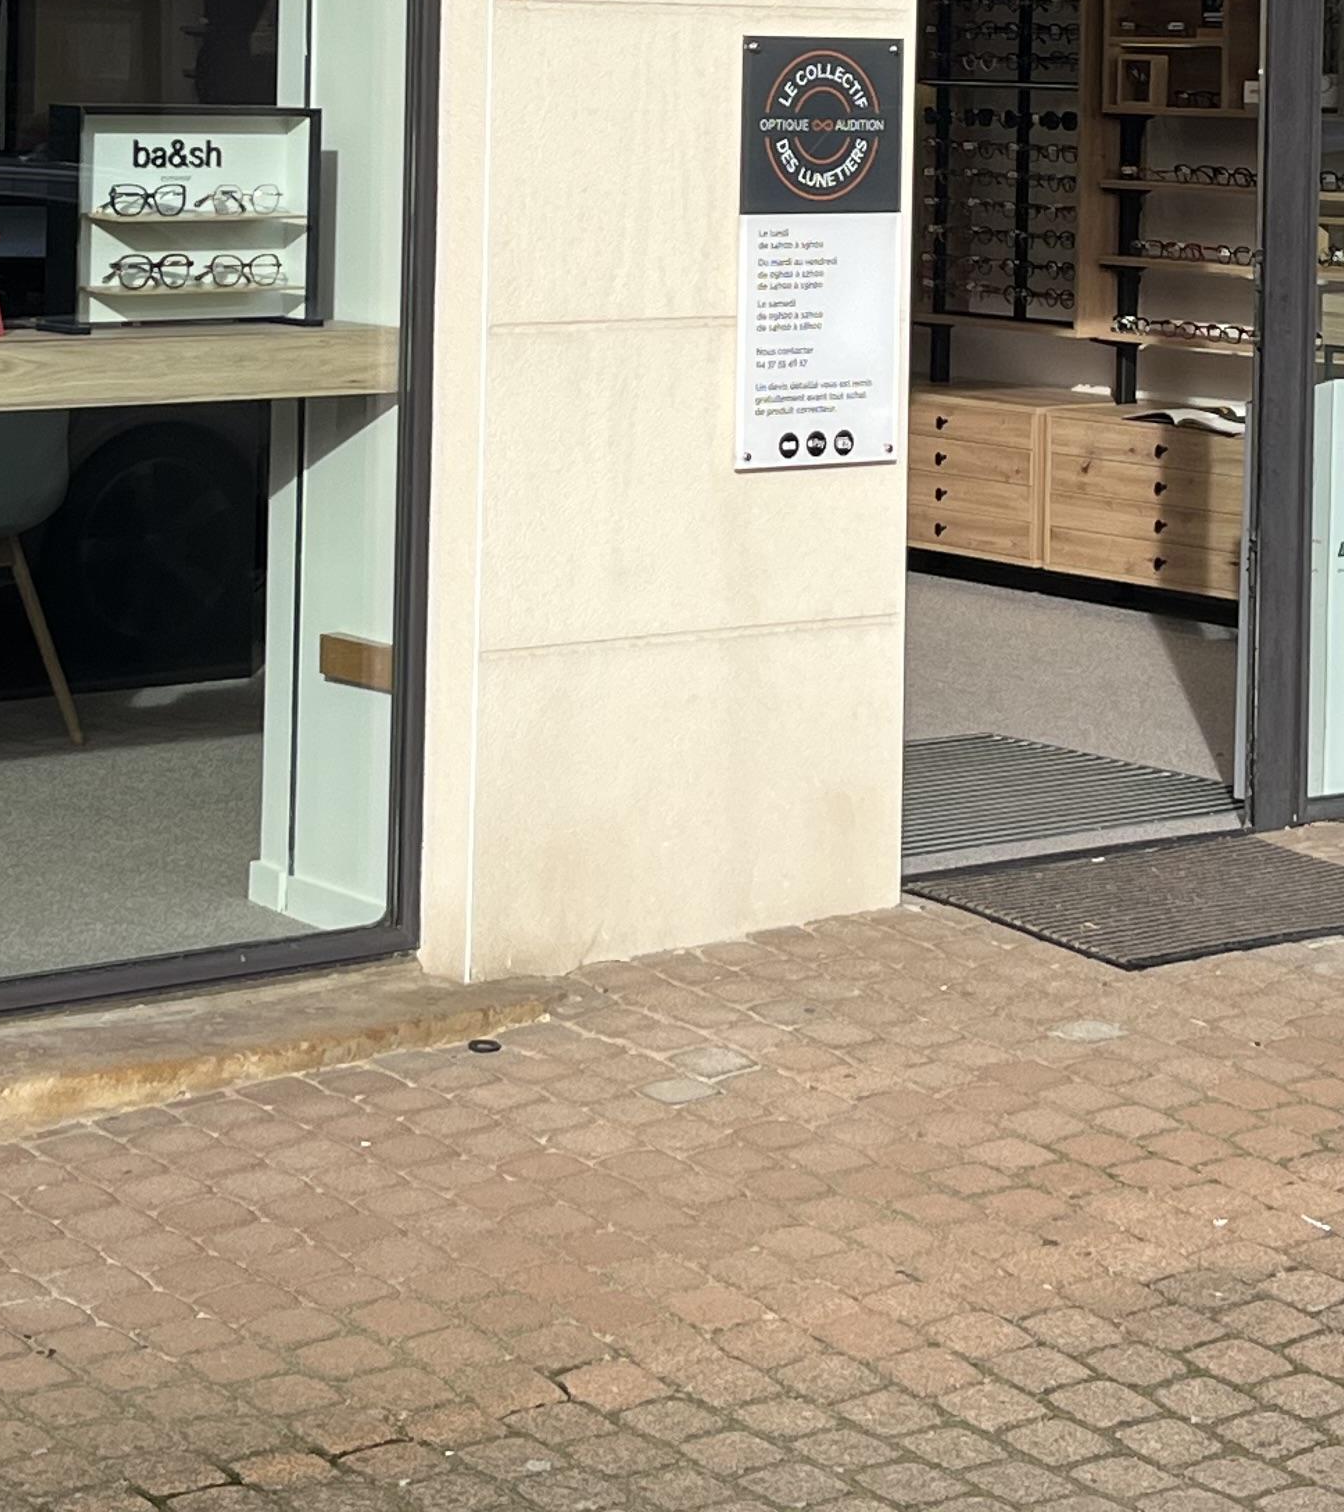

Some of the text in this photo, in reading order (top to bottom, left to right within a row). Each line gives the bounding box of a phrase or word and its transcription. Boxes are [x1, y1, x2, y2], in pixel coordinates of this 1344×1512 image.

[778, 63, 869, 108] LE COLLECTIF
[759, 119, 885, 131] OPTIQUE AUDITION
[132, 139, 222, 168] ba&sh
[776, 138, 868, 188] DES LUNETIERS
